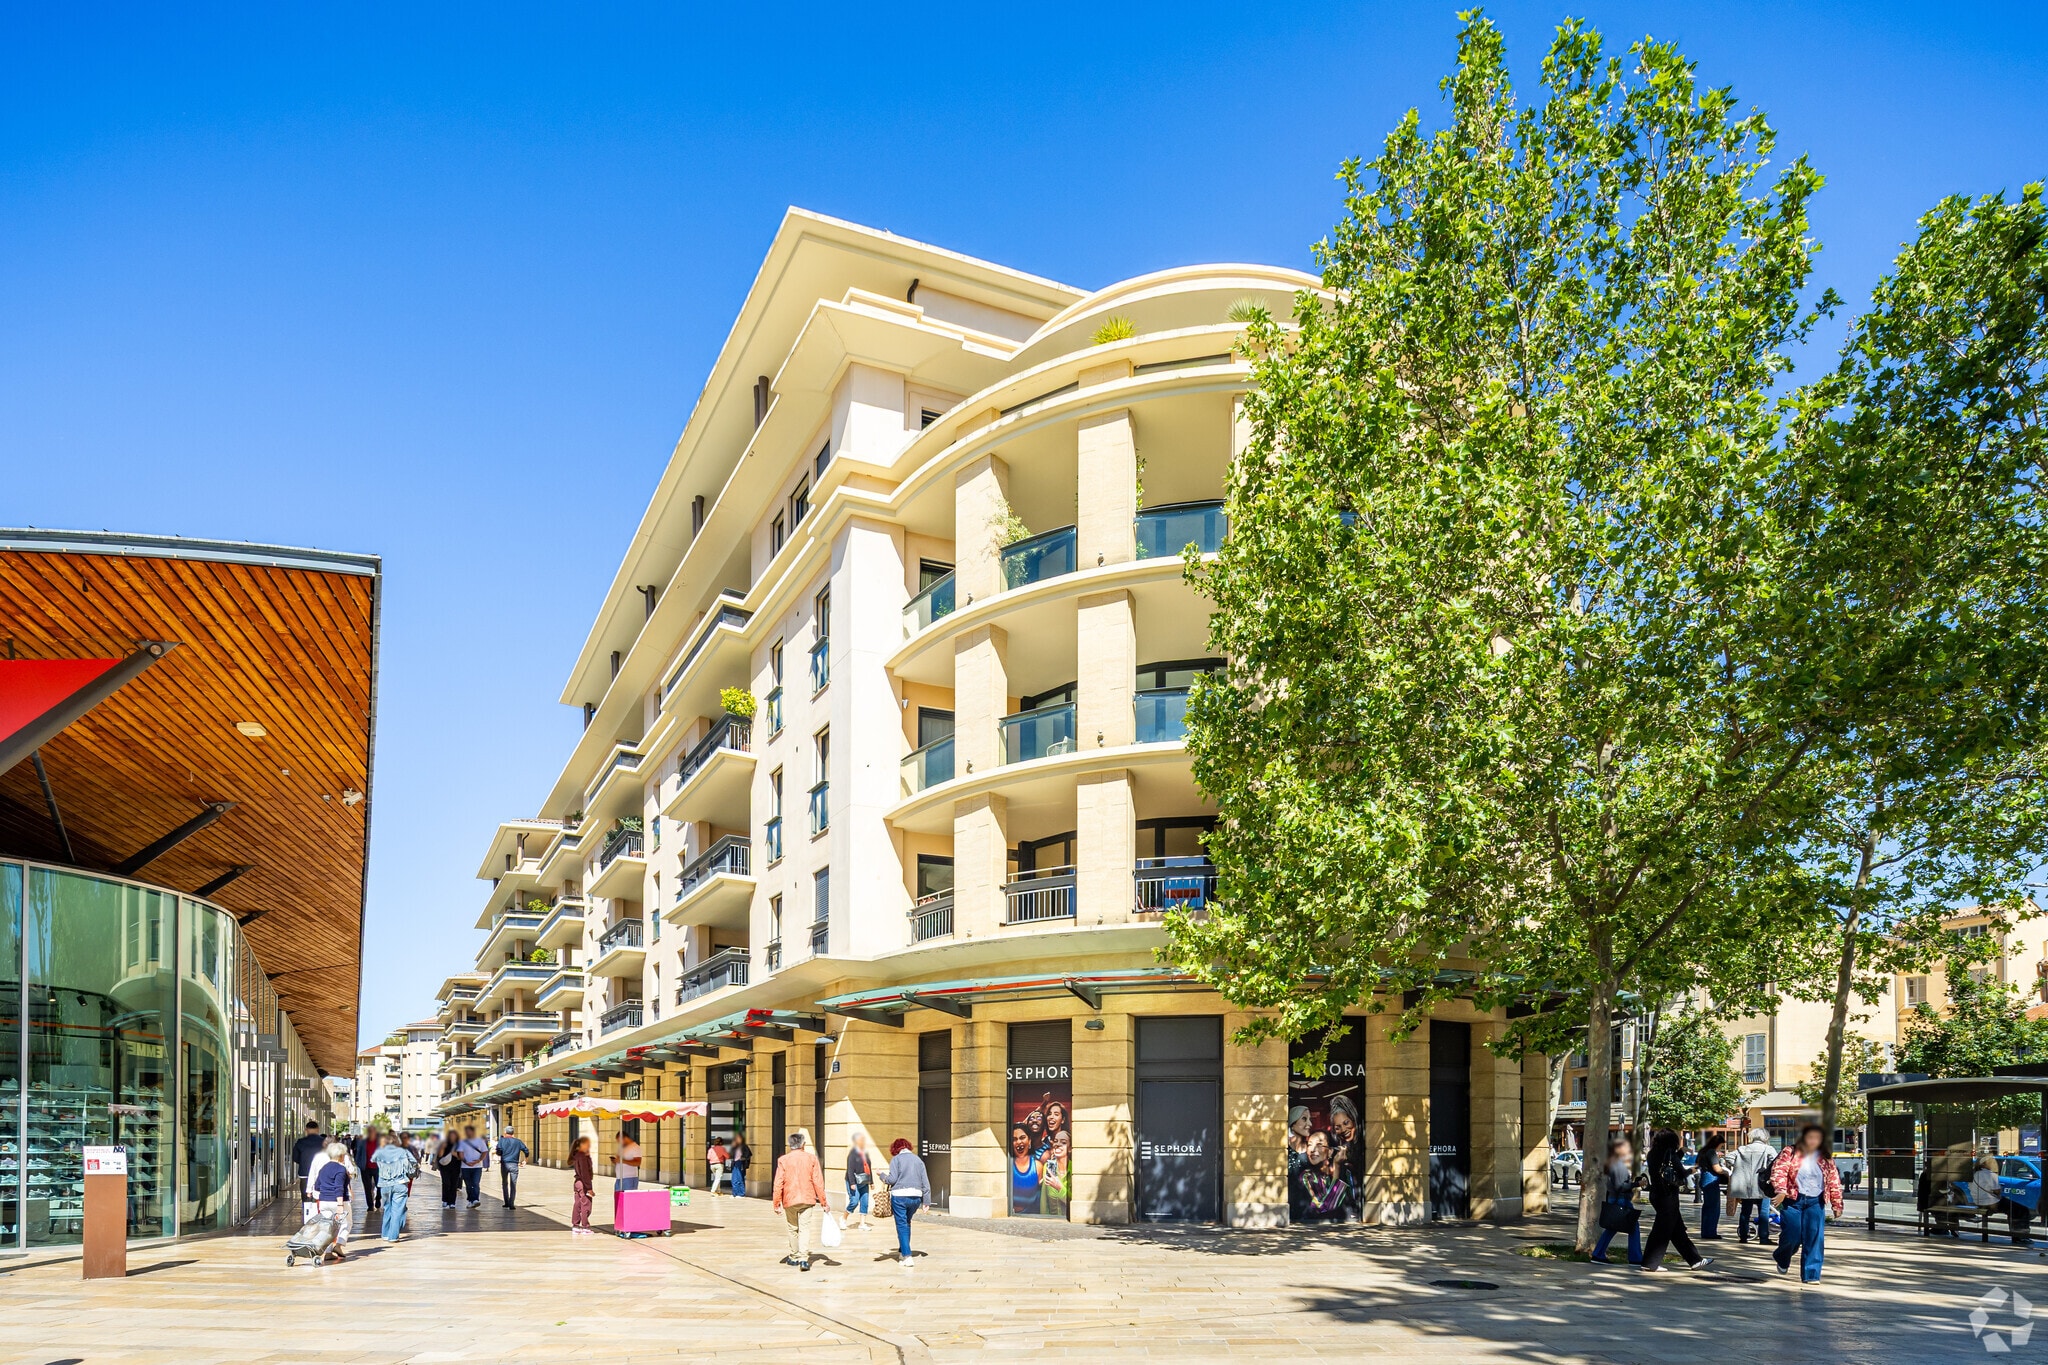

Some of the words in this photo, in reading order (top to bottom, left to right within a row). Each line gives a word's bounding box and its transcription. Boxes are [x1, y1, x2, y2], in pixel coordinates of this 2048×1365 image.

[1007, 1066, 1069, 1080] SEPHOR
[928, 1143, 951, 1151] SEPHOR
[1154, 1145, 1202, 1153] SEPHORA
